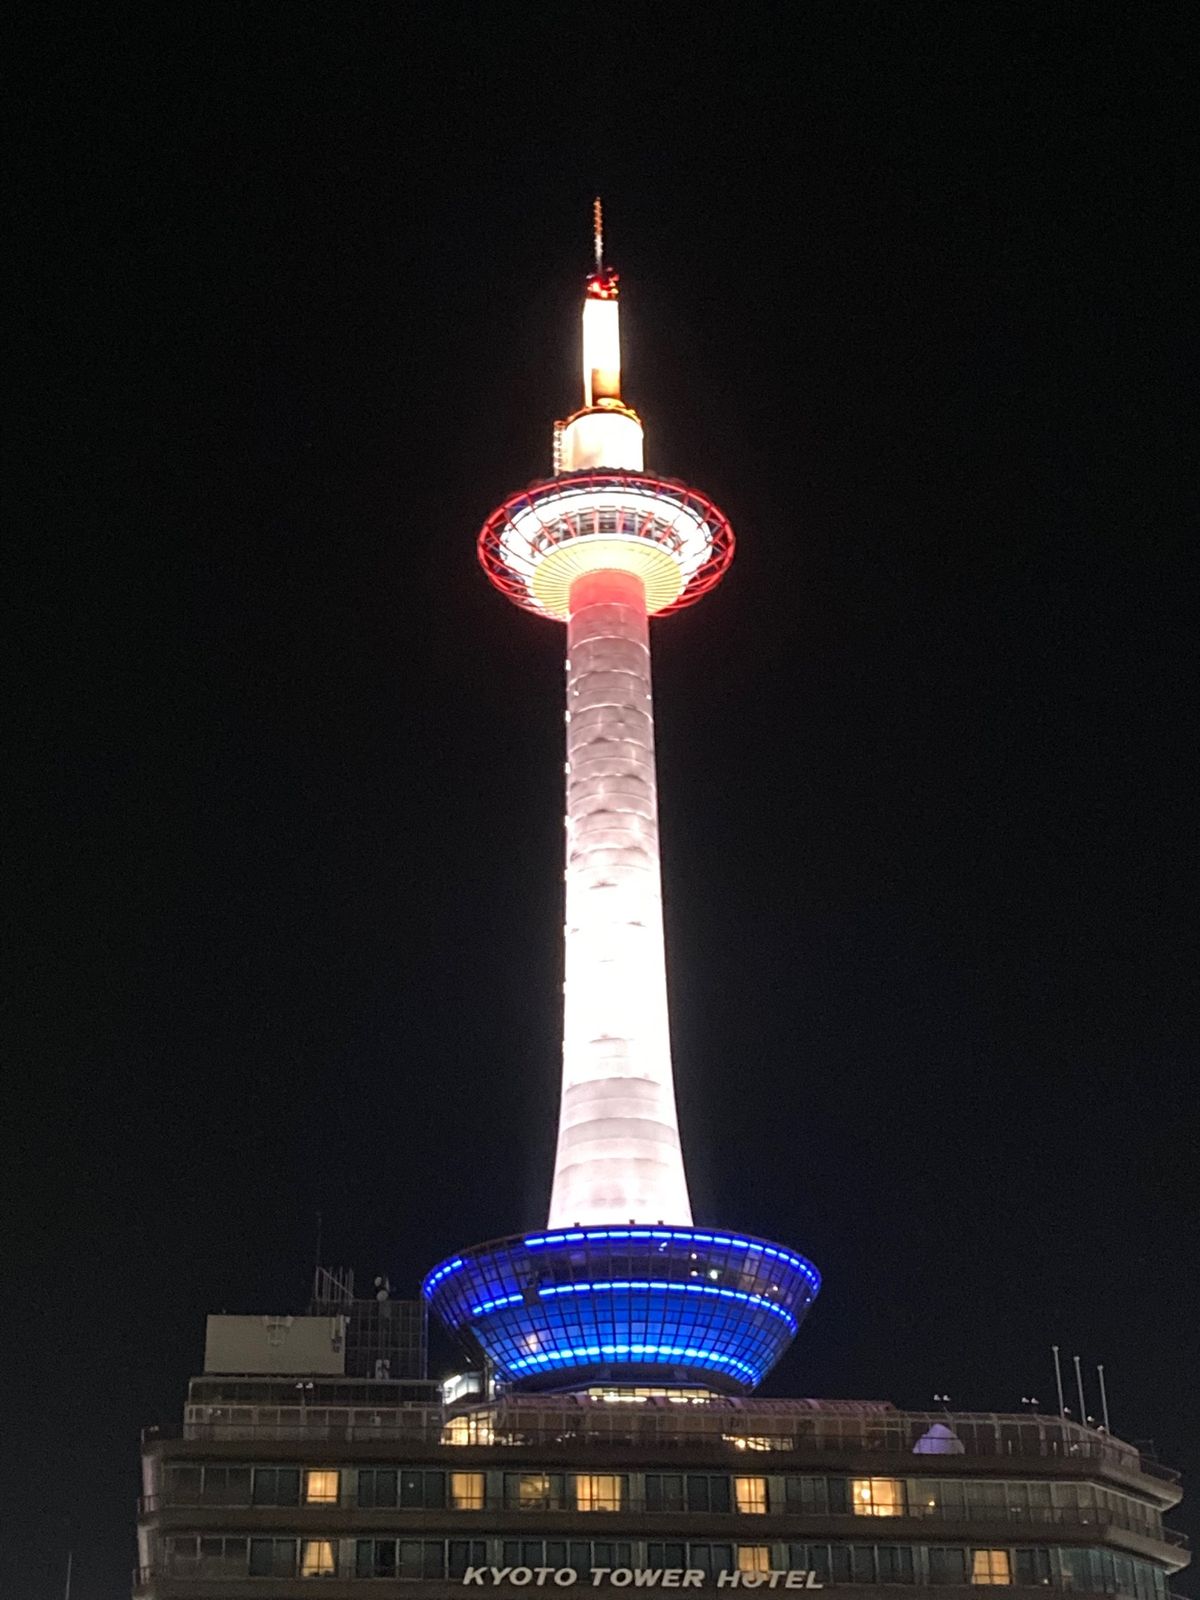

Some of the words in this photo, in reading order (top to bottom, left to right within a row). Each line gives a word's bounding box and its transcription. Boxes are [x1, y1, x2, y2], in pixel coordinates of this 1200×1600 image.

[462, 1566, 578, 1587] KYOTO
[589, 1567, 706, 1588] TOWER
[716, 1569, 824, 1589] HOTEL
